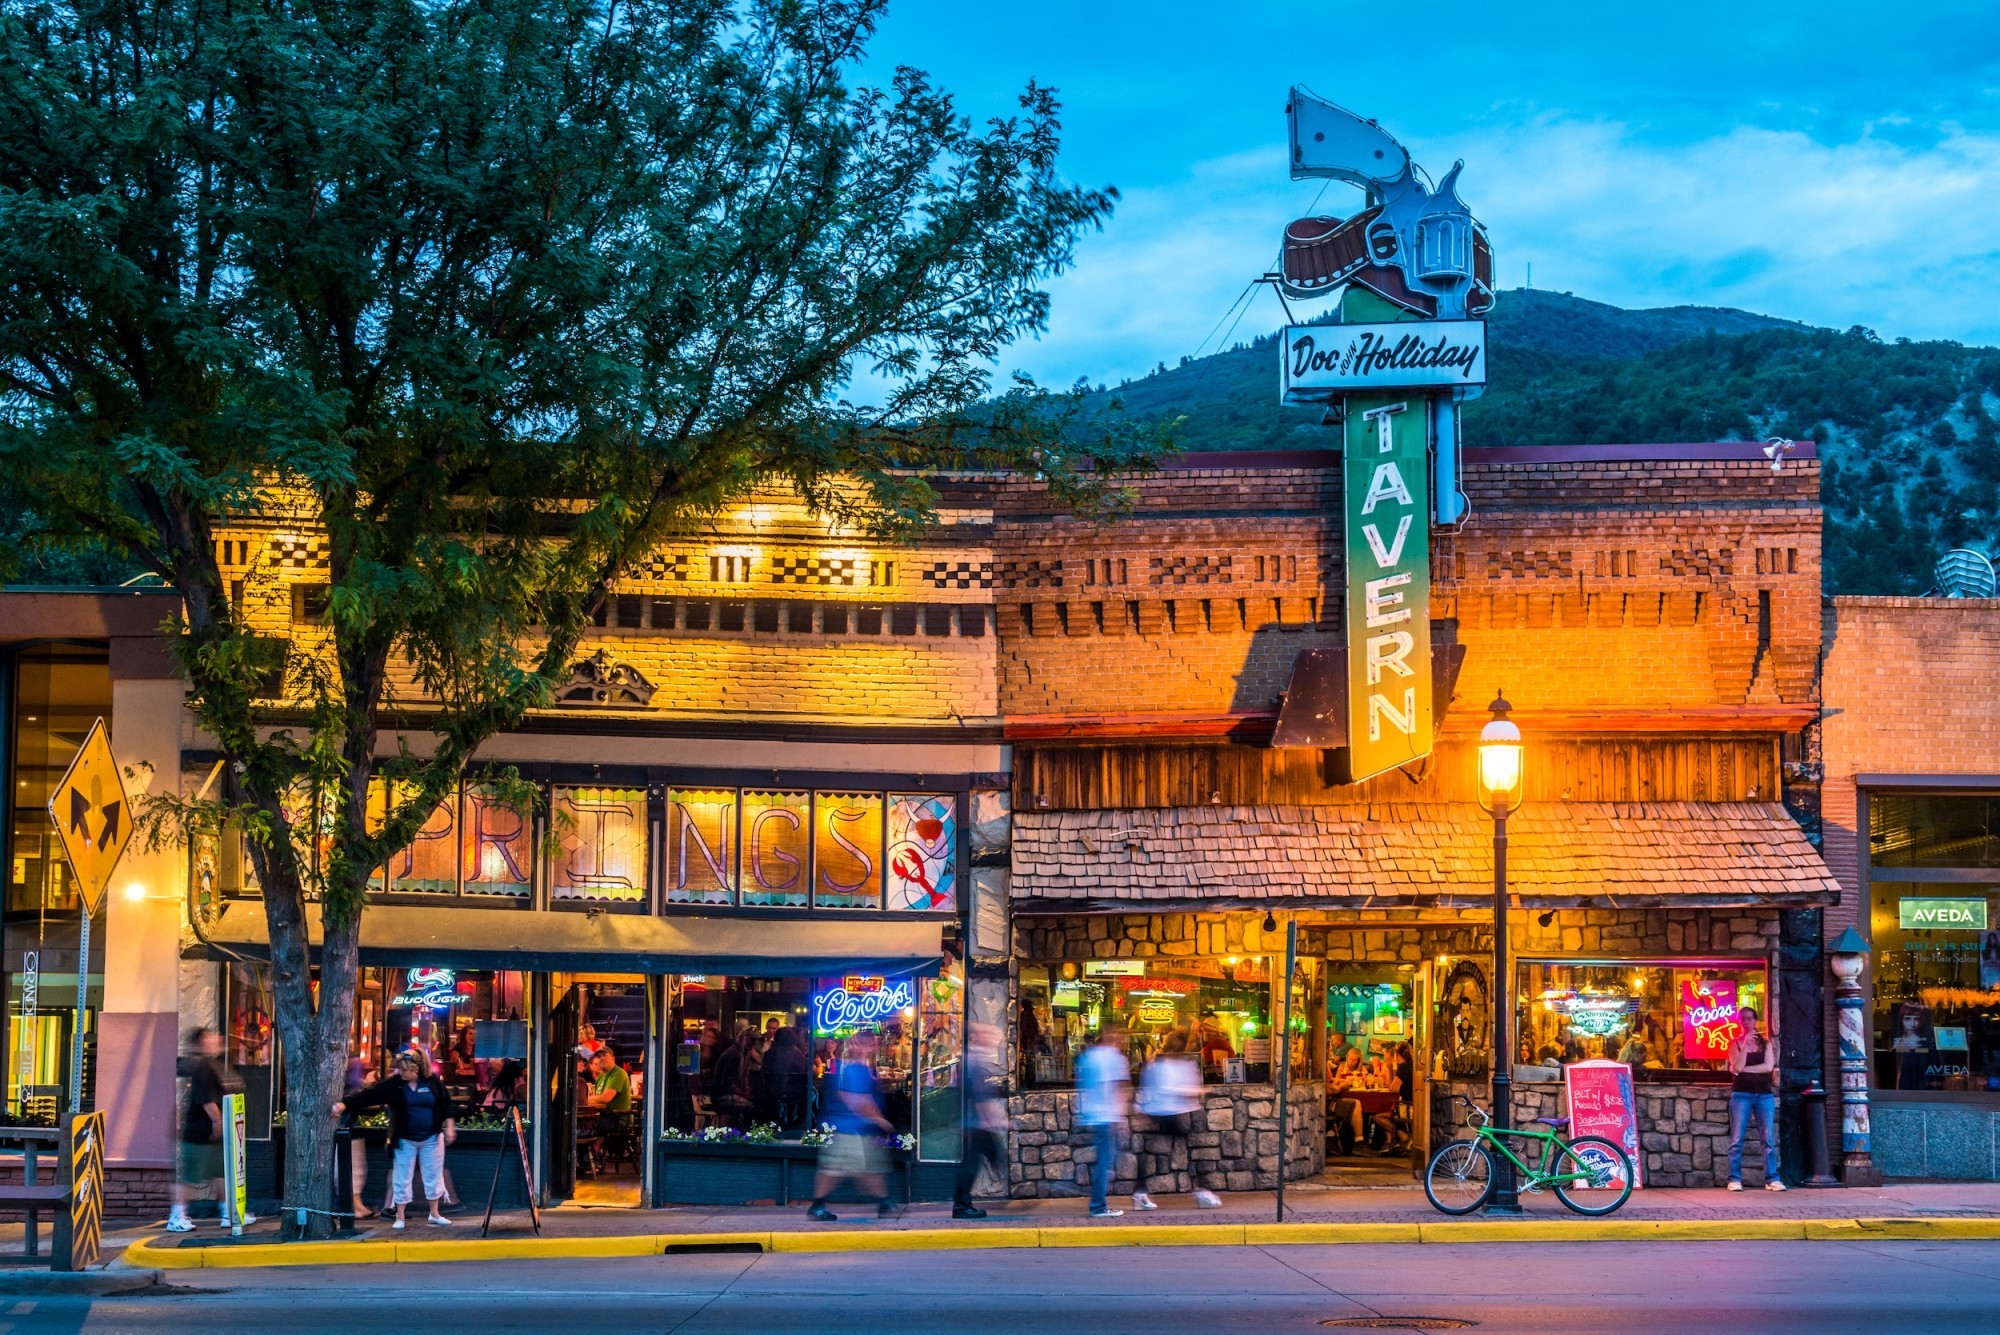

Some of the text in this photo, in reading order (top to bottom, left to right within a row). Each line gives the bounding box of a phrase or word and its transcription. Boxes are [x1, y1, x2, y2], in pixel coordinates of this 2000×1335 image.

[1292, 332, 1480, 379] Doc JOHN Holliday
[1362, 401, 1417, 743] TAVERN
[398, 793, 873, 893] PRINGS
[1912, 908, 1974, 922] AVEDA
[1914, 952, 1978, 963] The Hair Salon
[1119, 976, 1197, 991] Budweiser
[392, 995, 469, 1005] BUD LIGHT
[1566, 998, 1626, 1010] Budweiser
[815, 982, 912, 1033] Coors
[1138, 1008, 1175, 1018] BURGERS
[1690, 1004, 1735, 1027] Coors
[1925, 1065, 1969, 1074] AVEDA
[1574, 1089, 1591, 1099] BLT
[1577, 1128, 1605, 1138] Chicken
